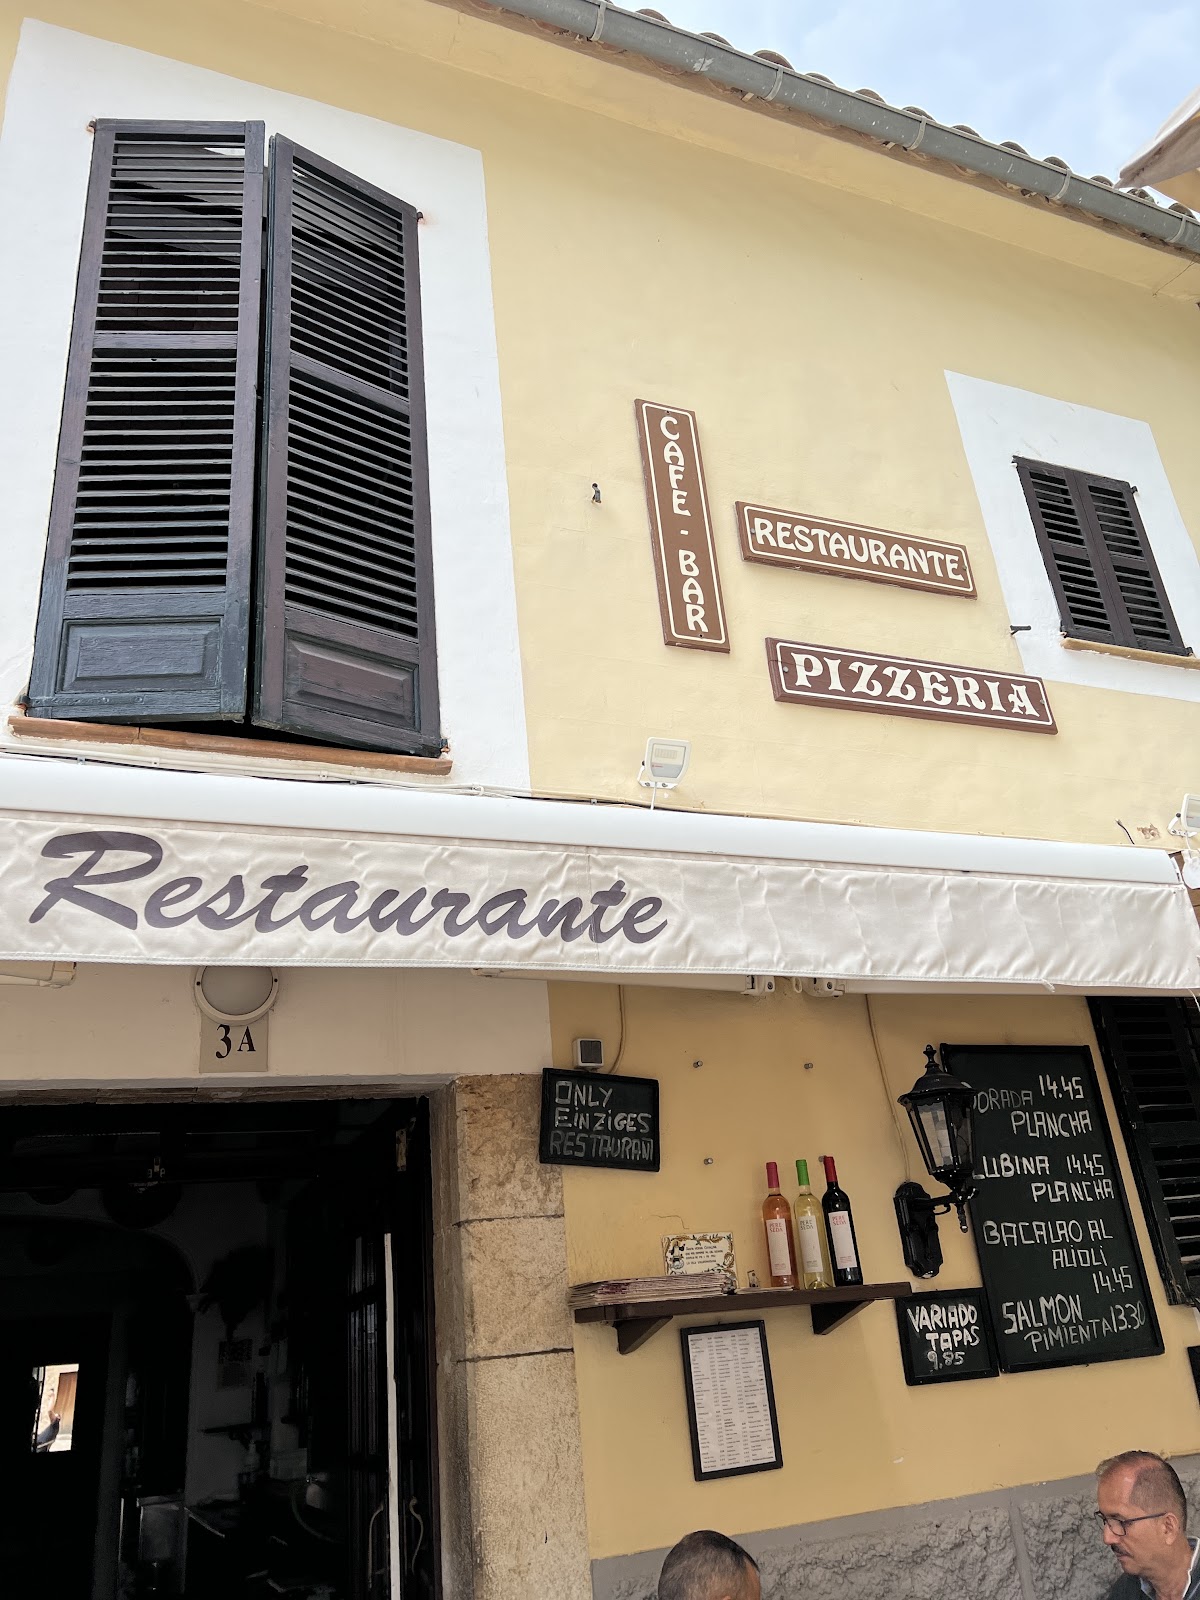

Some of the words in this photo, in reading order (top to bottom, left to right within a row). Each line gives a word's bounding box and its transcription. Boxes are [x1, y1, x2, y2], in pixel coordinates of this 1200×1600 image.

[659, 415, 691, 517] CAFE
[677, 549, 708, 633] BAR
[754, 517, 965, 581] RESTAURANTE
[790, 652, 1040, 718] PIZZERIA
[28, 830, 668, 944] Restaurante
[555, 1080, 613, 1108] ONLY
[1039, 1074, 1084, 1100] 14.45
[1010, 1109, 1092, 1139] PLANCHA
[1066, 1153, 1105, 1177] 14.45
[1031, 1178, 1115, 1203] PLANCHA
[983, 1219, 1083, 1247] BACALAO
[1088, 1219, 1114, 1242] AL
[1093, 1265, 1134, 1294] 14.45
[907, 1303, 978, 1333] VARIADO
[1002, 1293, 1083, 1335] SALMON
[926, 1325, 981, 1353] TAPAS
[927, 1350, 966, 1370] 9.85
